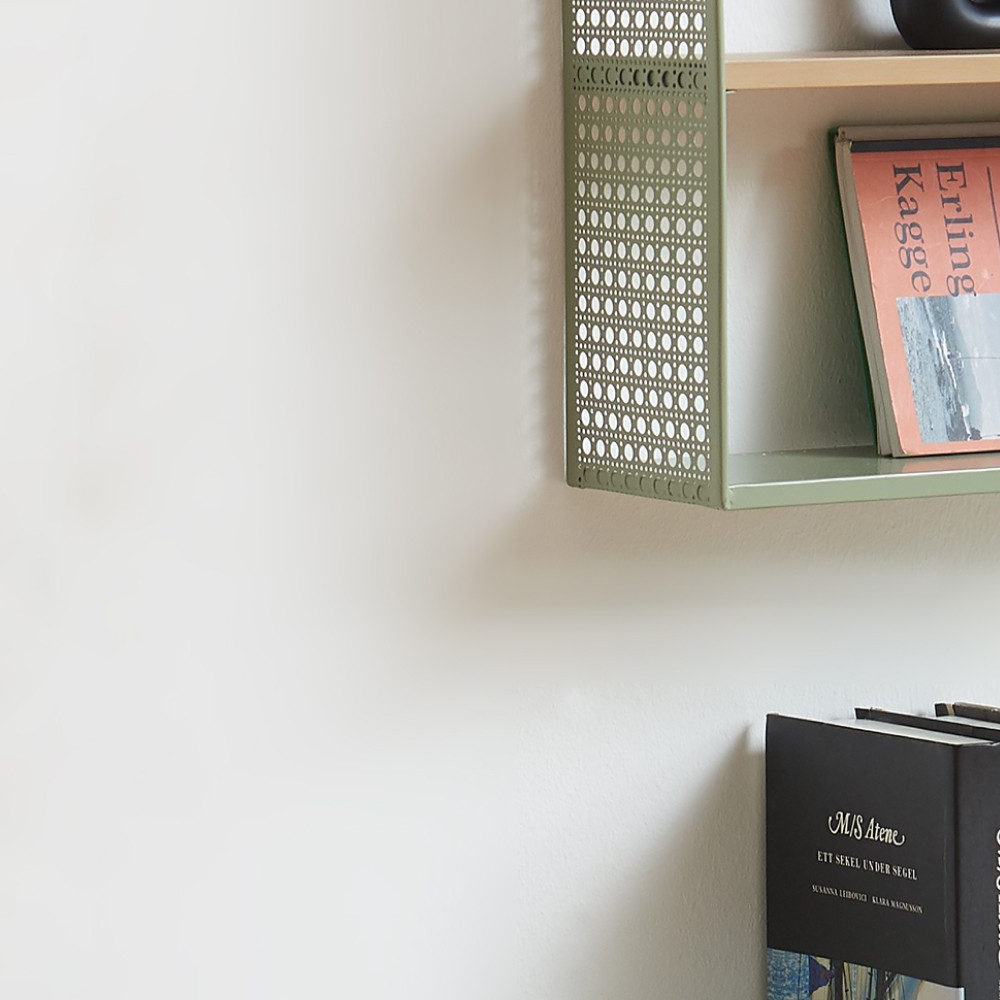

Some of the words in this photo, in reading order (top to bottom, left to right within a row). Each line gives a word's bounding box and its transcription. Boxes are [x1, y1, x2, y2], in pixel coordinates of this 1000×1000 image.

[892, 163, 932, 293] Kagge
[935, 161, 977, 297] Erling
[817, 850, 834, 863] ETT
[835, 854, 861, 868] SEKEL
[863, 859, 891, 875] UNDER
[892, 865, 918, 880] SEGEL
[827, 811, 863, 840] M/S
[864, 817, 906, 846] Atene
